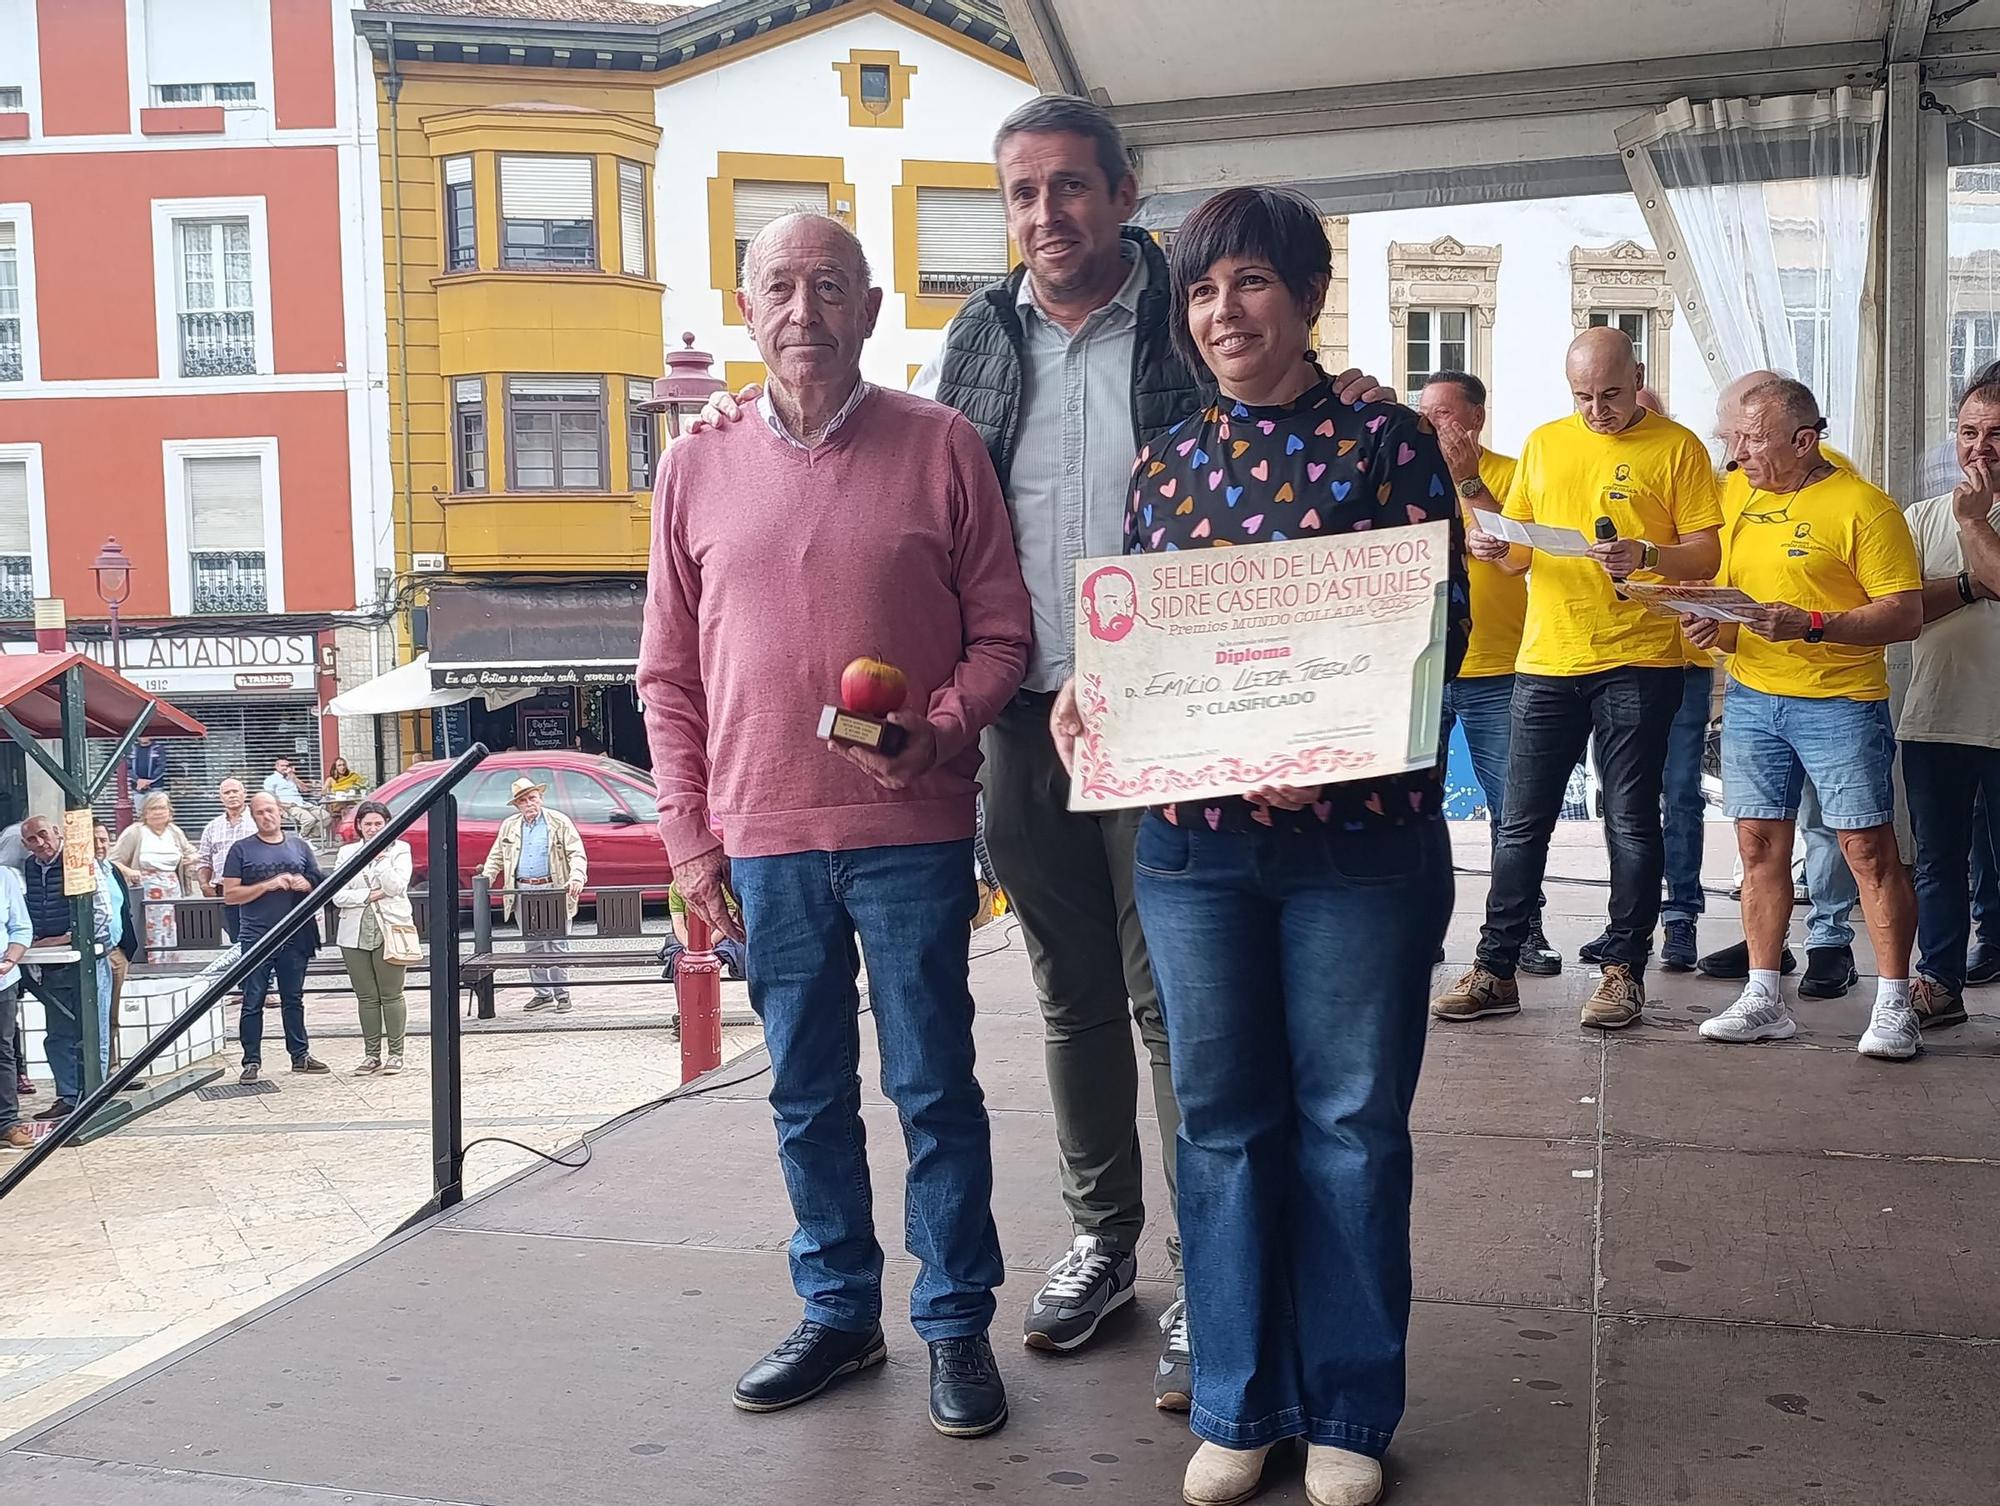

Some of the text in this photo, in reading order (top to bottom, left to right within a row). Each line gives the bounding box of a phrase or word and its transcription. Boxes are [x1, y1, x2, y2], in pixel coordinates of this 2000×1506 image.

[1152, 539, 1432, 591] SELEICIÓN DE LA MEYOR
[1151, 567, 1431, 620] SIDRE CASERO D'ASTURIES
[1168, 621, 1228, 636] Premios
[1231, 613, 1290, 631] MUNDO
[1215, 646, 1291, 666] Diploma
[146, 679, 168, 690] 1912
[247, 674, 293, 684] TABACOS
[1206, 691, 1317, 715] CLASIFICADO
